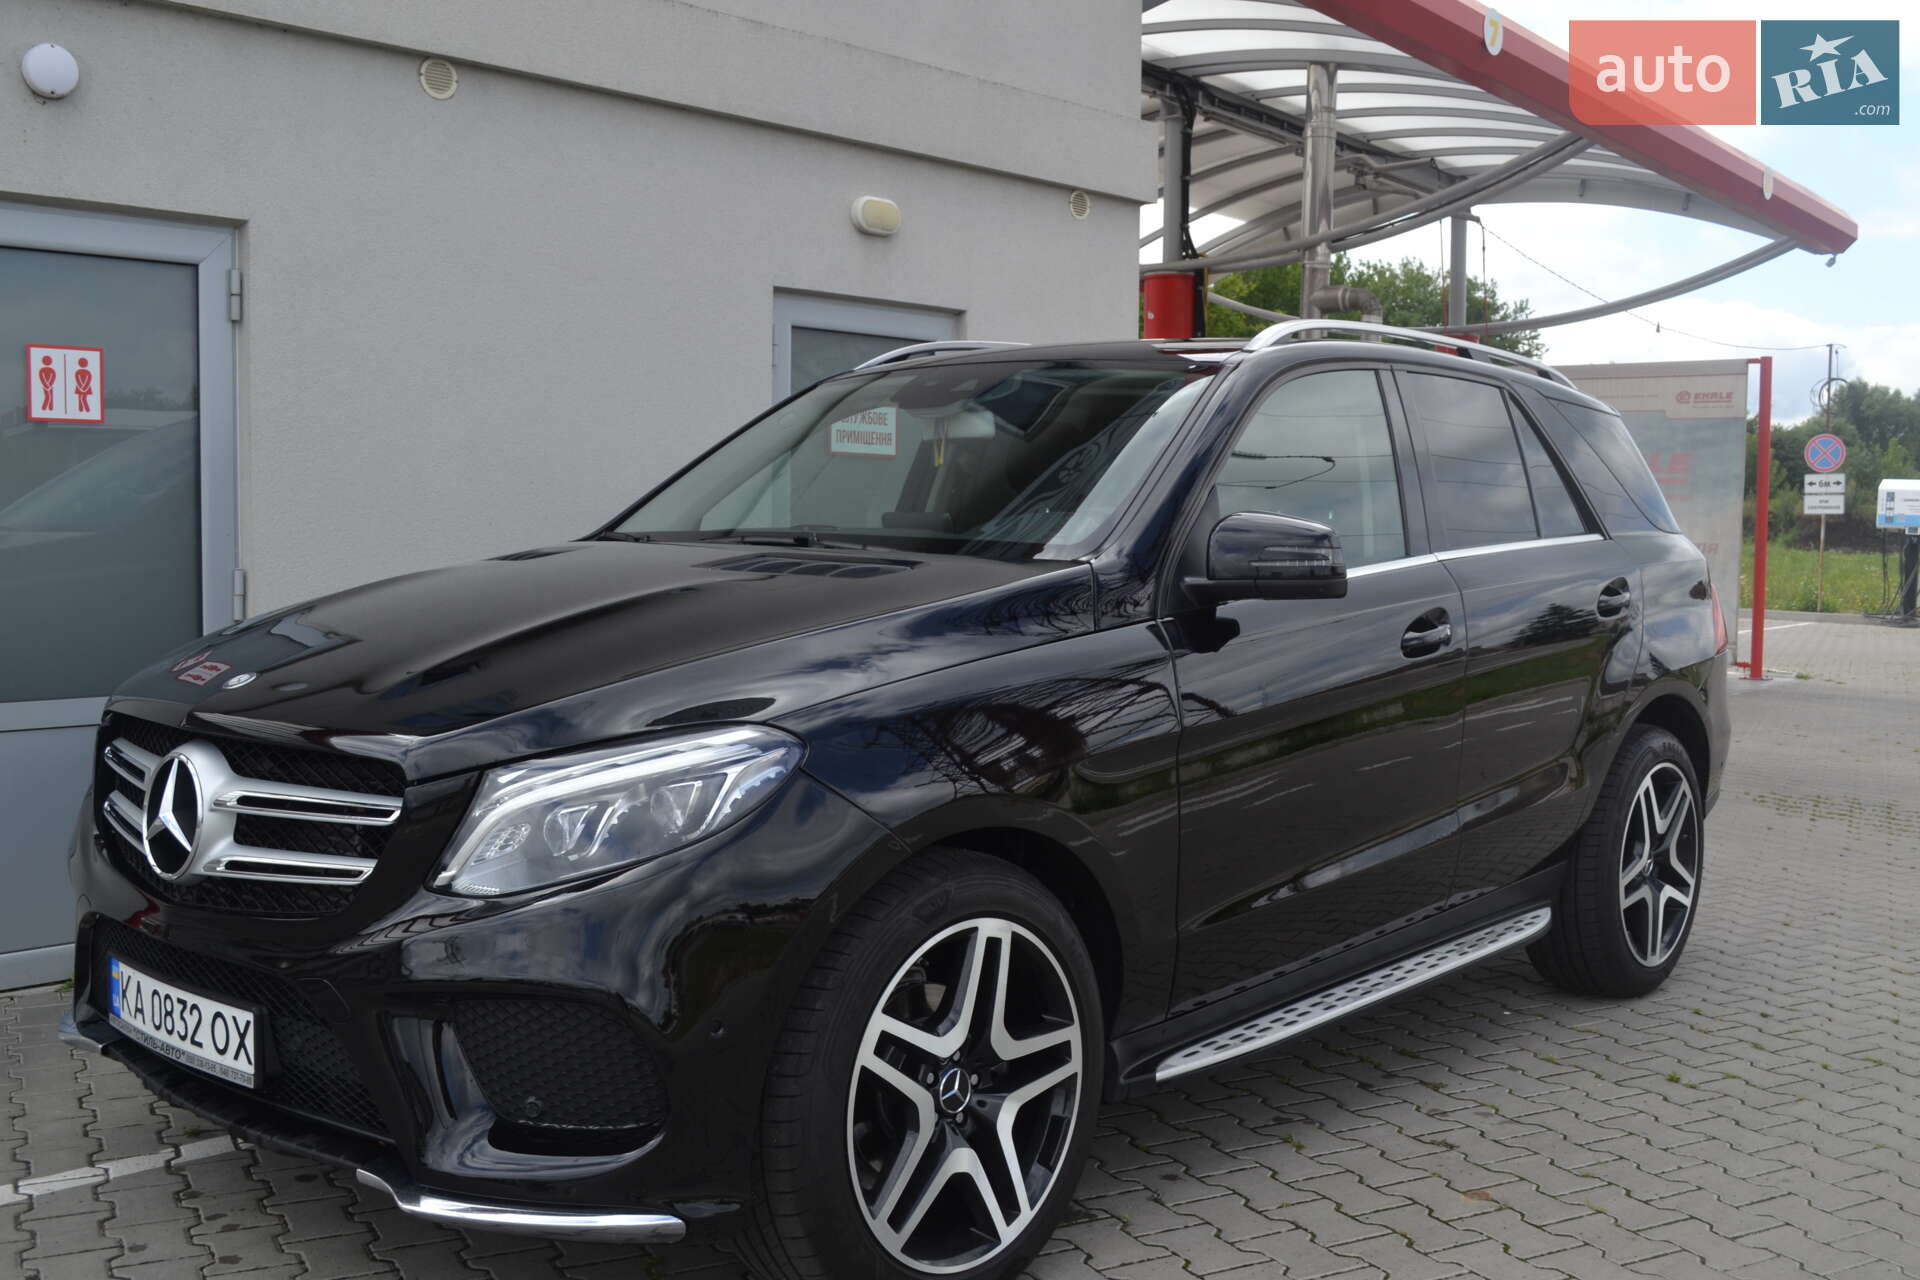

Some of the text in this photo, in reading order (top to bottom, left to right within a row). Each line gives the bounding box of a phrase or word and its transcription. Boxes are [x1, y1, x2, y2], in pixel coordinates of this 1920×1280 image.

[1488, 18, 1500, 48] 7
[120, 971, 253, 1066] KA 0832 OX
